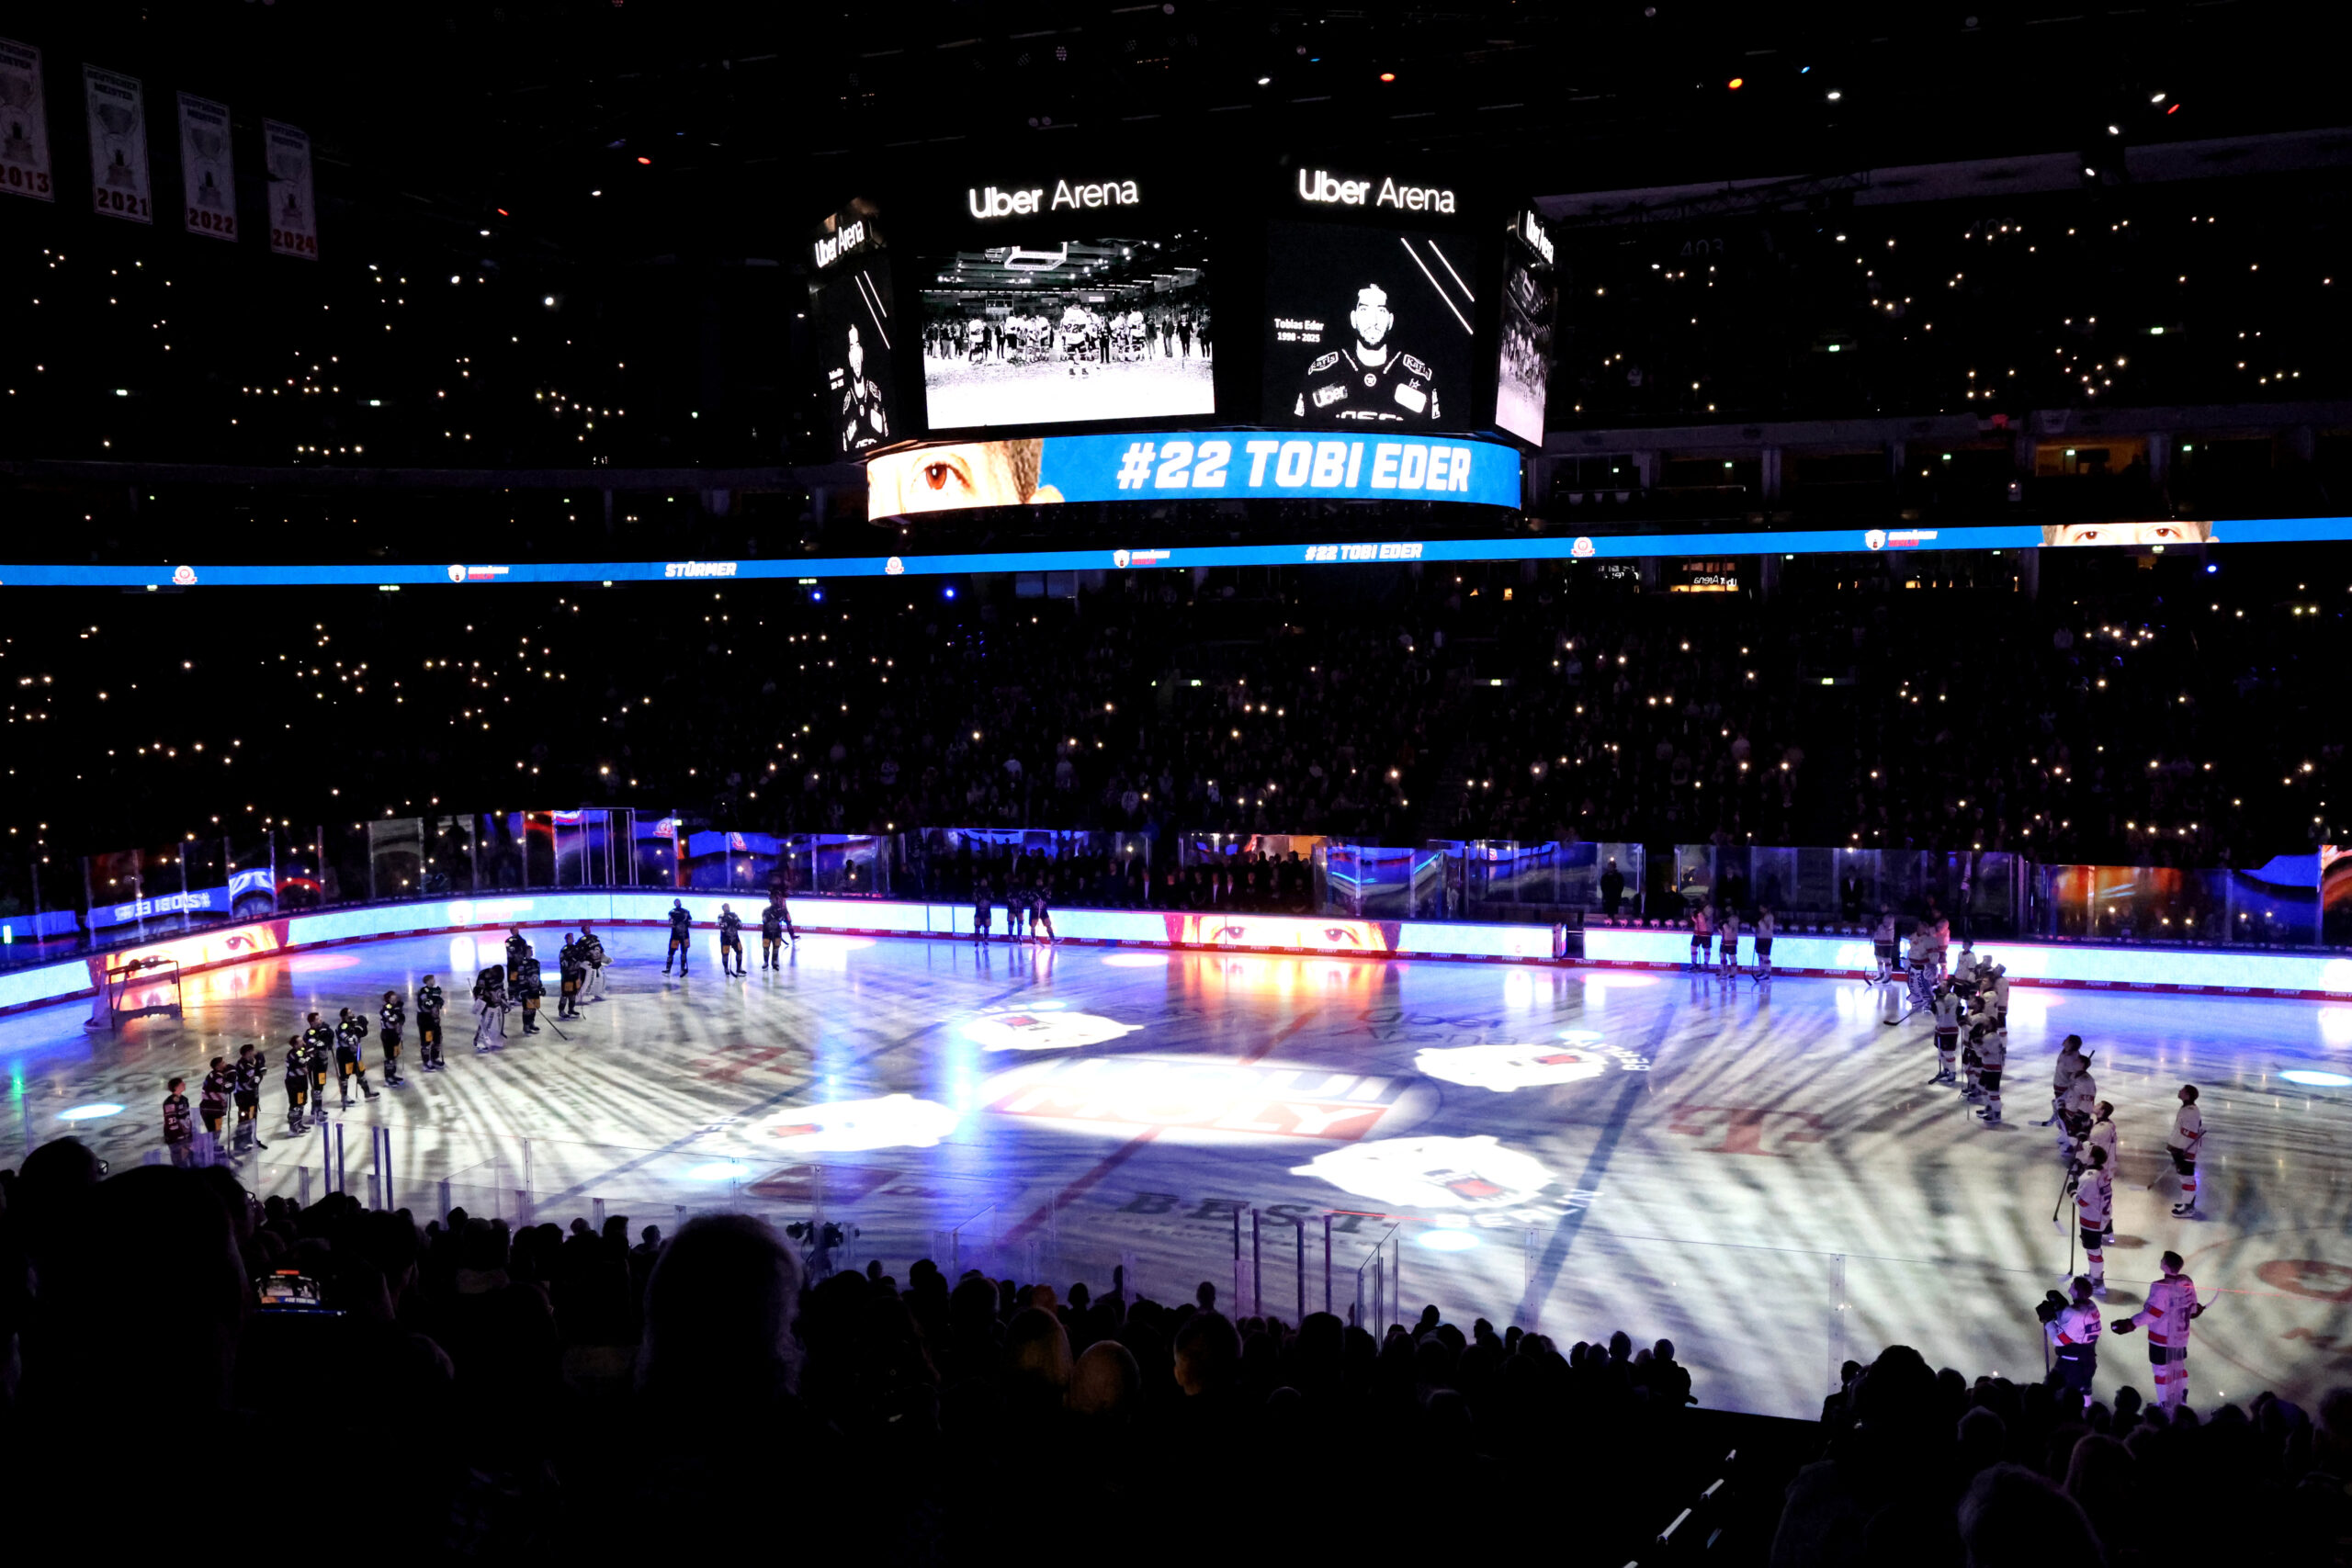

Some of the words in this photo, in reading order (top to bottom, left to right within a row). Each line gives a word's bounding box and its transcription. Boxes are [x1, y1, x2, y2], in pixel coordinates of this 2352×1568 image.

[97, 187, 149, 217] 2021
[968, 186, 1044, 220] Uber
[1051, 179, 1139, 211] Arena
[1298, 168, 1371, 206] Uber
[1376, 175, 1455, 213] Arena
[188, 208, 234, 235] 2022
[272, 229, 317, 254] 2024
[814, 220, 837, 268] Uber
[839, 220, 865, 255] Arena
[1273, 317, 1304, 331] Tobias
[1116, 440, 1233, 491] #22
[1246, 440, 1365, 489] TOBI
[1370, 443, 1473, 492] EDER
[1305, 545, 1339, 561] #22
[1340, 544, 1378, 560] TOBI
[1379, 543, 1423, 559] EDER
[664, 560, 738, 578] STÜRMER
[1114, 1190, 1387, 1235] BEST
